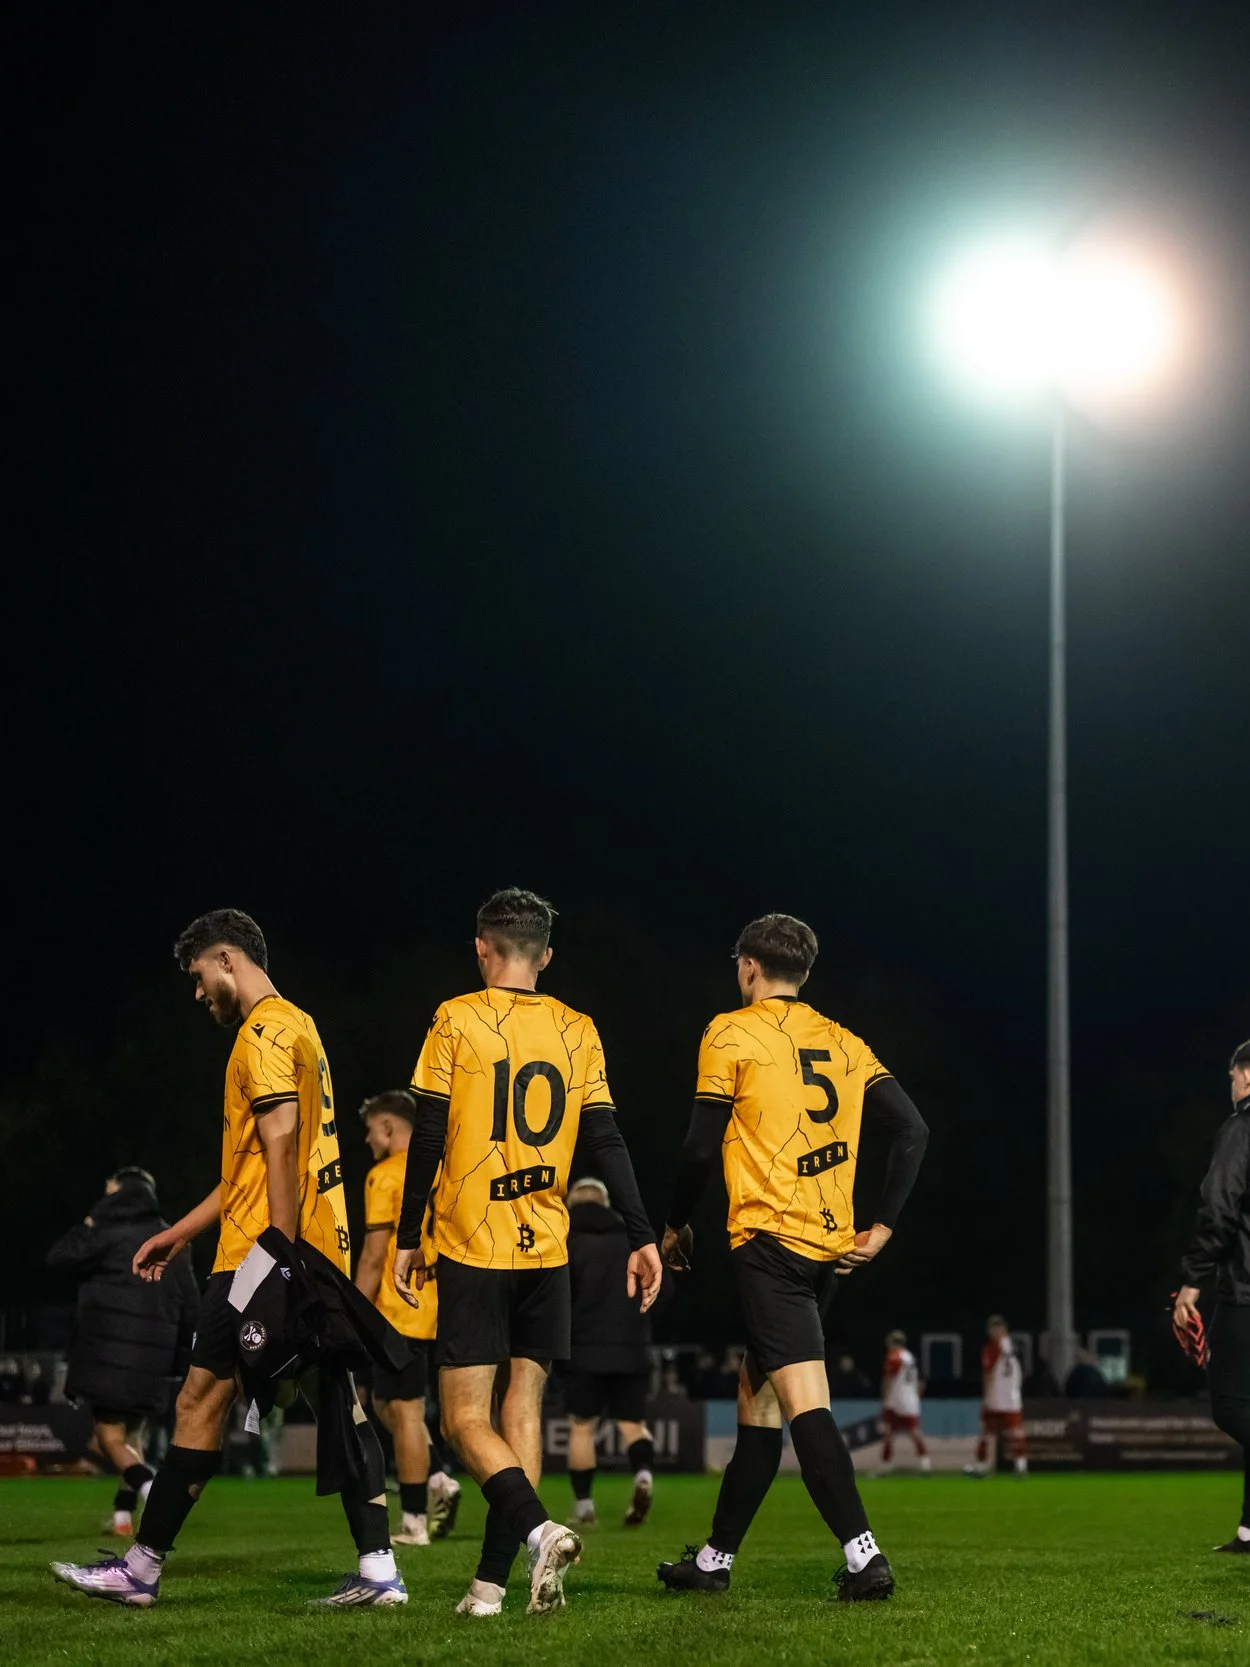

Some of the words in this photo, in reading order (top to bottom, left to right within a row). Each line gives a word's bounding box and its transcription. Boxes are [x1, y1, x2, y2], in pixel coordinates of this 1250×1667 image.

[489, 1057, 566, 1147] 10
[798, 1048, 840, 1124] 5
[496, 1169, 550, 1197] IREN
[801, 1145, 845, 1173] IREN
